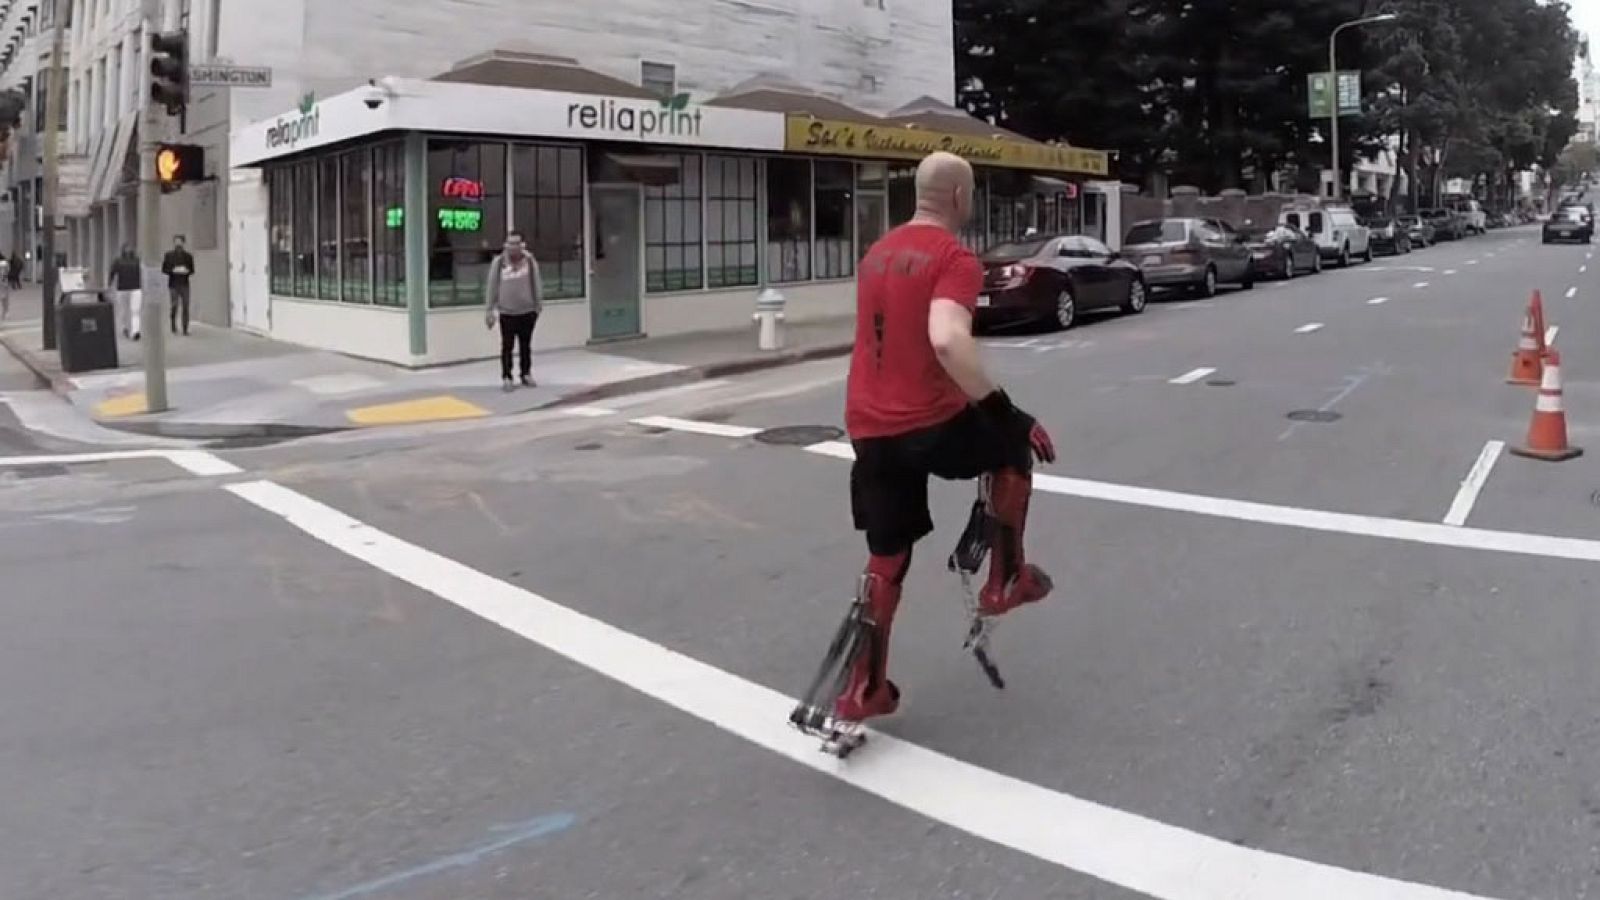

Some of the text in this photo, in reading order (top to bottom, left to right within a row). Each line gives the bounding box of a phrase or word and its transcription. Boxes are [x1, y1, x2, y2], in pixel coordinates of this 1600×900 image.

[191, 69, 267, 83] SHINGTON
[266, 106, 319, 148] reliaprint
[568, 99, 702, 138] reliaprint
